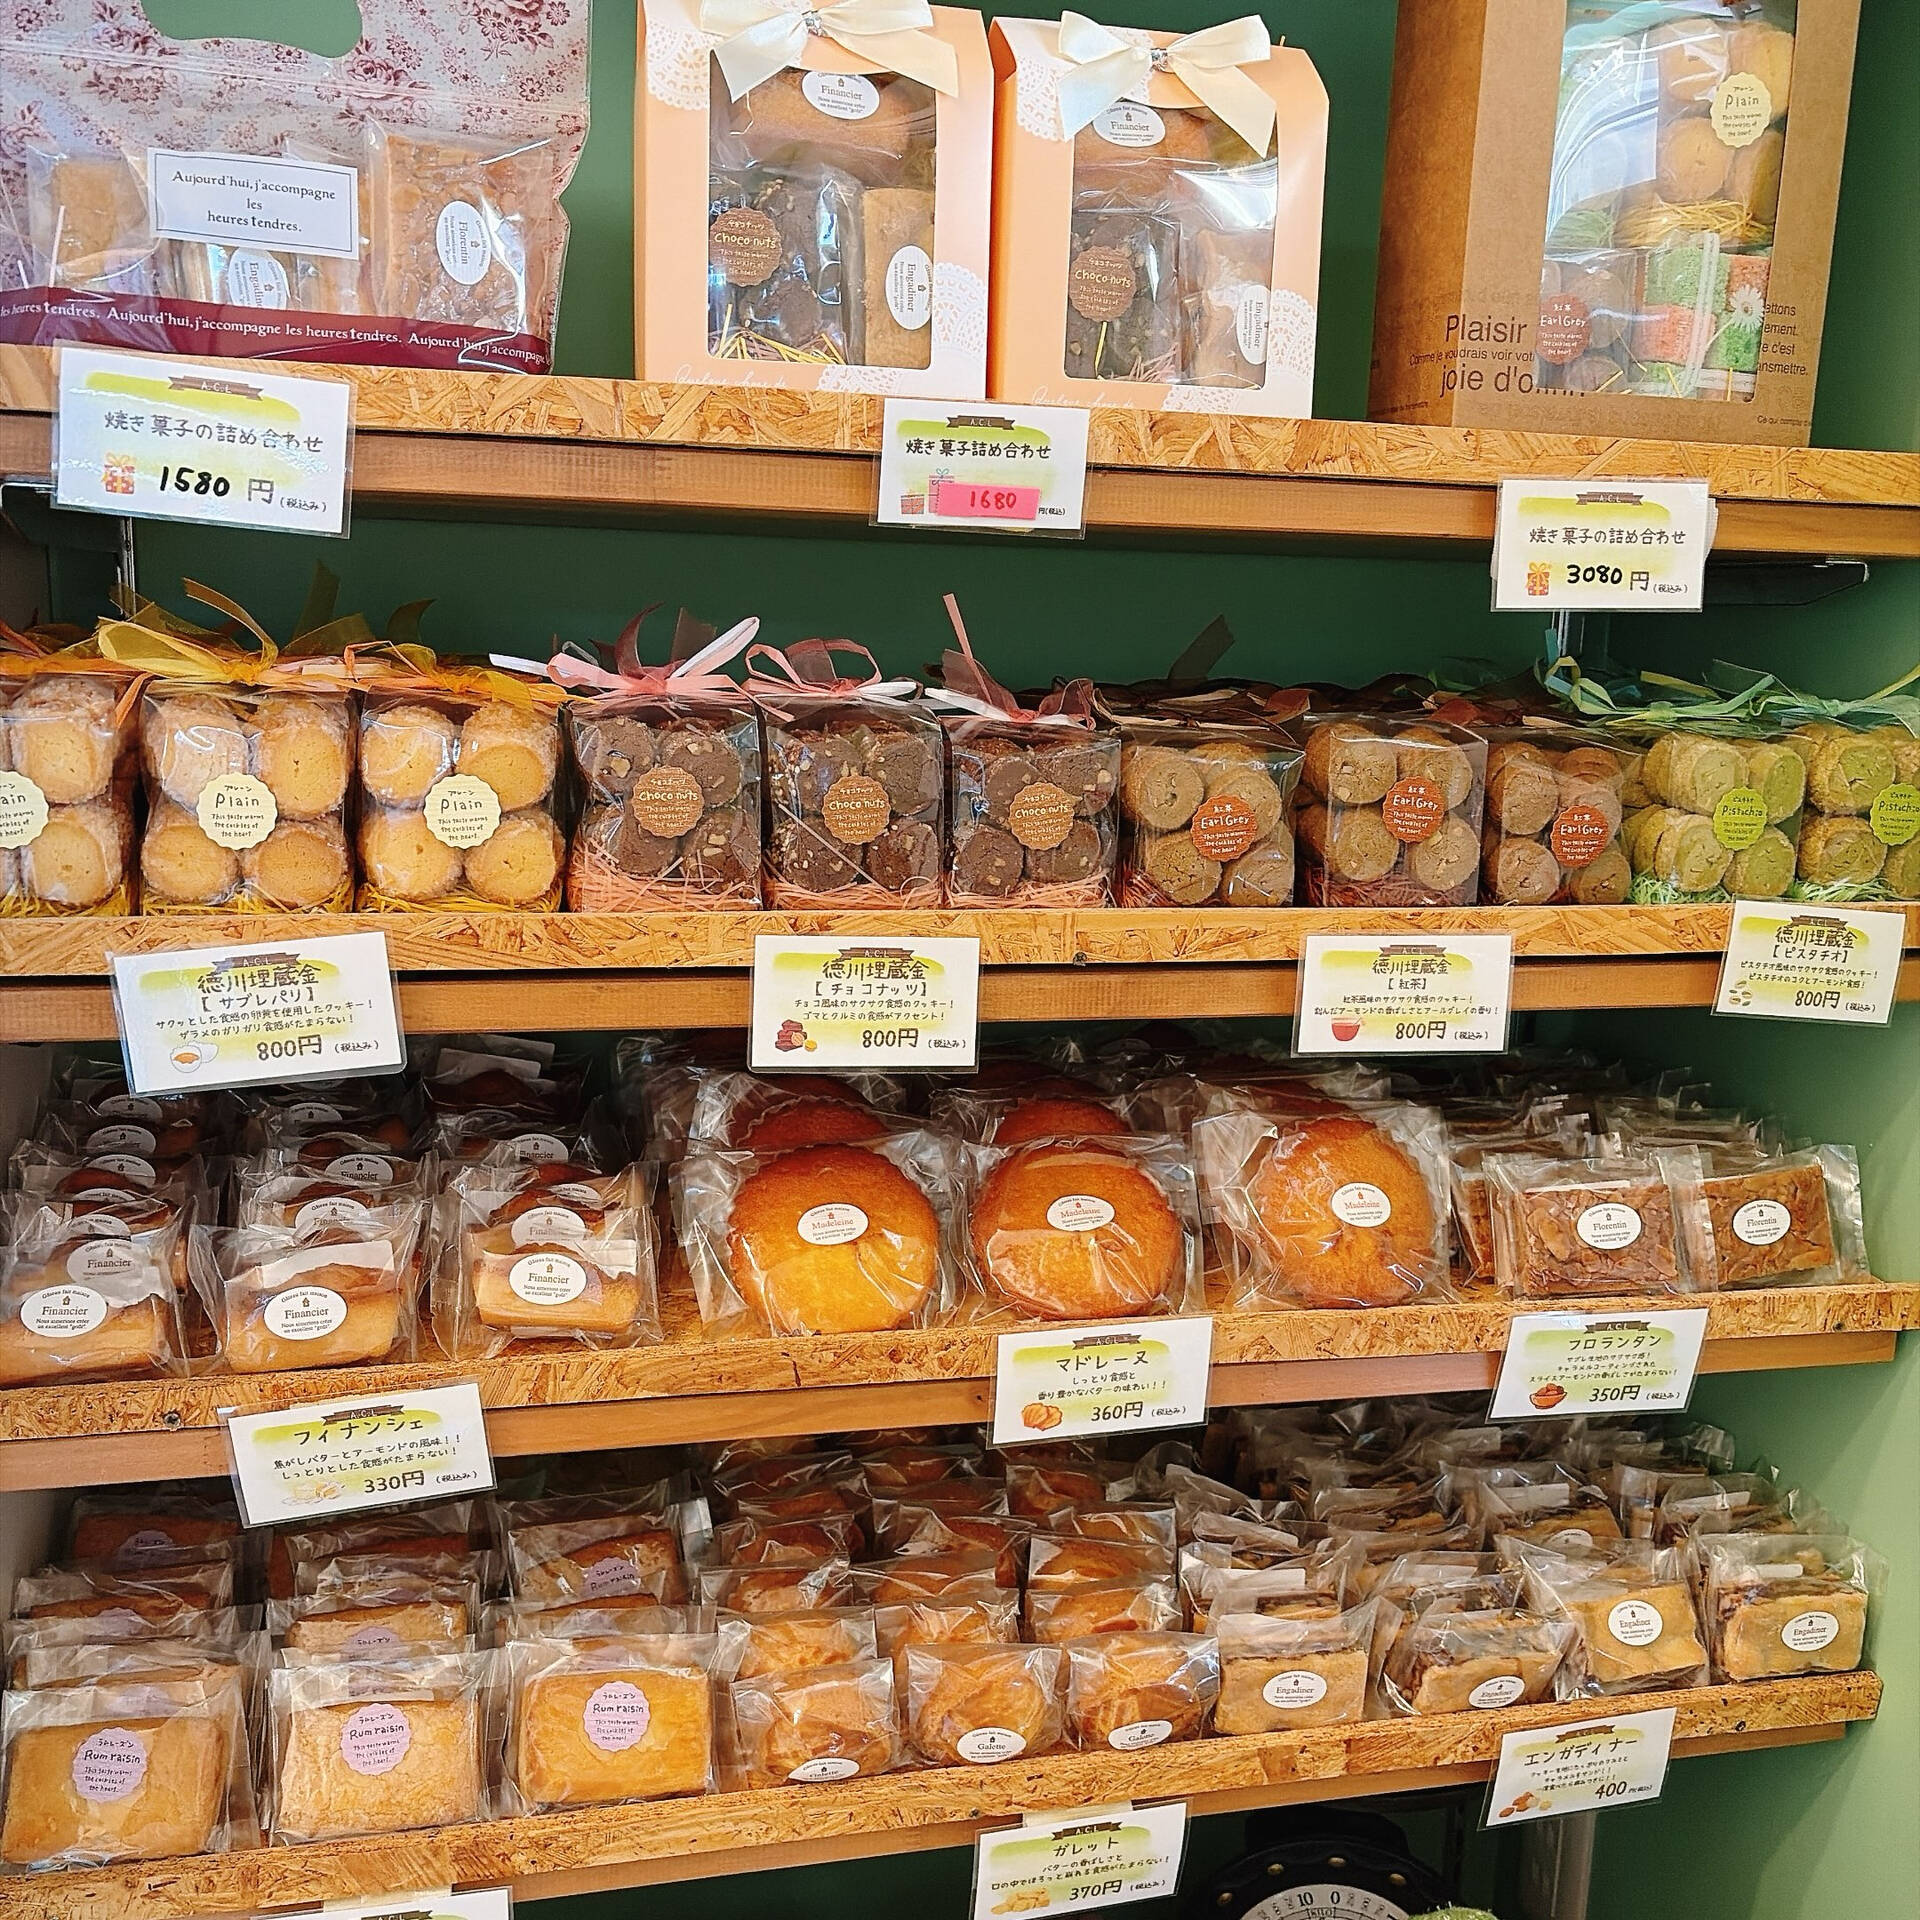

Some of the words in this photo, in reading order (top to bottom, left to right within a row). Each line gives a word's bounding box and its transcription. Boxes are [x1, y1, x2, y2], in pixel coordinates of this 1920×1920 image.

[821, 85, 862, 100] Financier
[1725, 94, 1759, 110] Plain
[1111, 120, 1150, 131] Financier
[247, 198, 263, 211] les
[207, 210, 249, 226] heures
[251, 215, 302, 233] tendres.
[458, 221, 469, 265] Florentin
[753, 236, 776, 249] nuts
[905, 263, 917, 312] Engadiner
[44, 301, 100, 320] tendres.
[285, 323, 302, 336] les
[306, 327, 348, 341] heures
[349, 328, 402, 344] tendres.
[1254, 301, 1263, 349] Engadiner
[1445, 314, 1528, 343] Plaisir
[1540, 314, 1562, 327] Earl
[1563, 315, 1586, 328] Grey
[1444, 347, 1488, 359] voudrais
[1492, 349, 1512, 360] voir
[1772, 342, 1795, 355] c'est
[1440, 363, 1484, 398] joie
[159, 466, 231, 497] 1580
[248, 477, 275, 504] 円
[969, 489, 1017, 511] 1680
[1566, 563, 1623, 585] 3080
[1629, 570, 1650, 591] 円
[215, 792, 260, 808] Plain
[639, 790, 673, 801] Choco
[676, 790, 698, 800] nuts
[1393, 795, 1414, 806] Earl
[1416, 798, 1438, 811] Grey
[440, 799, 482, 814] Plain
[829, 801, 861, 810] Choco
[864, 798, 885, 808] nuts
[1015, 808, 1046, 818] Choco
[1048, 803, 1068, 813] nuts
[1722, 805, 1762, 816] Pistachio
[1201, 816, 1223, 829] Earl
[1225, 815, 1250, 826] Grey
[1560, 825, 1581, 835] Earl
[1582, 824, 1603, 835] Grey
[1775, 926, 1858, 949] 徳川埋蔵金
[821, 960, 930, 981] 徳川埋蔵金
[1371, 959, 1452, 975] 徳川埋蔵金
[197, 963, 321, 994] 徳川埋蔵金
[1794, 990, 1841, 1009] 800円
[1395, 1020, 1447, 1040] 800円
[862, 1028, 919, 1049] 800円
[256, 1034, 323, 1062] 800円
[1593, 1221, 1627, 1230] Florentin
[87, 1259, 132, 1268] Financier
[528, 1272, 570, 1284] Financier
[42, 1306, 88, 1315] Financier
[284, 1308, 329, 1319] Financier
[1569, 1334, 1662, 1351] フロランタン
[1589, 1384, 1642, 1403] 350円
[1091, 1401, 1144, 1422] 360円
[294, 1417, 424, 1446] フィナンシェ
[364, 1469, 425, 1495] 330円
[593, 1703, 614, 1713] Rum
[616, 1705, 644, 1713] raisin
[349, 1729, 372, 1740] Rum
[374, 1725, 404, 1735] raisin
[84, 1750, 108, 1761] Rum
[110, 1753, 141, 1764] raisin
[1524, 1738, 1638, 1766] エンガディナー
[1595, 1781, 1627, 1800] 400
[1053, 1837, 1121, 1857] ガレット
[1069, 1880, 1122, 1901] 370円
[1297, 1892, 1314, 1907] 10
[1330, 1891, 1341, 1904] 0
